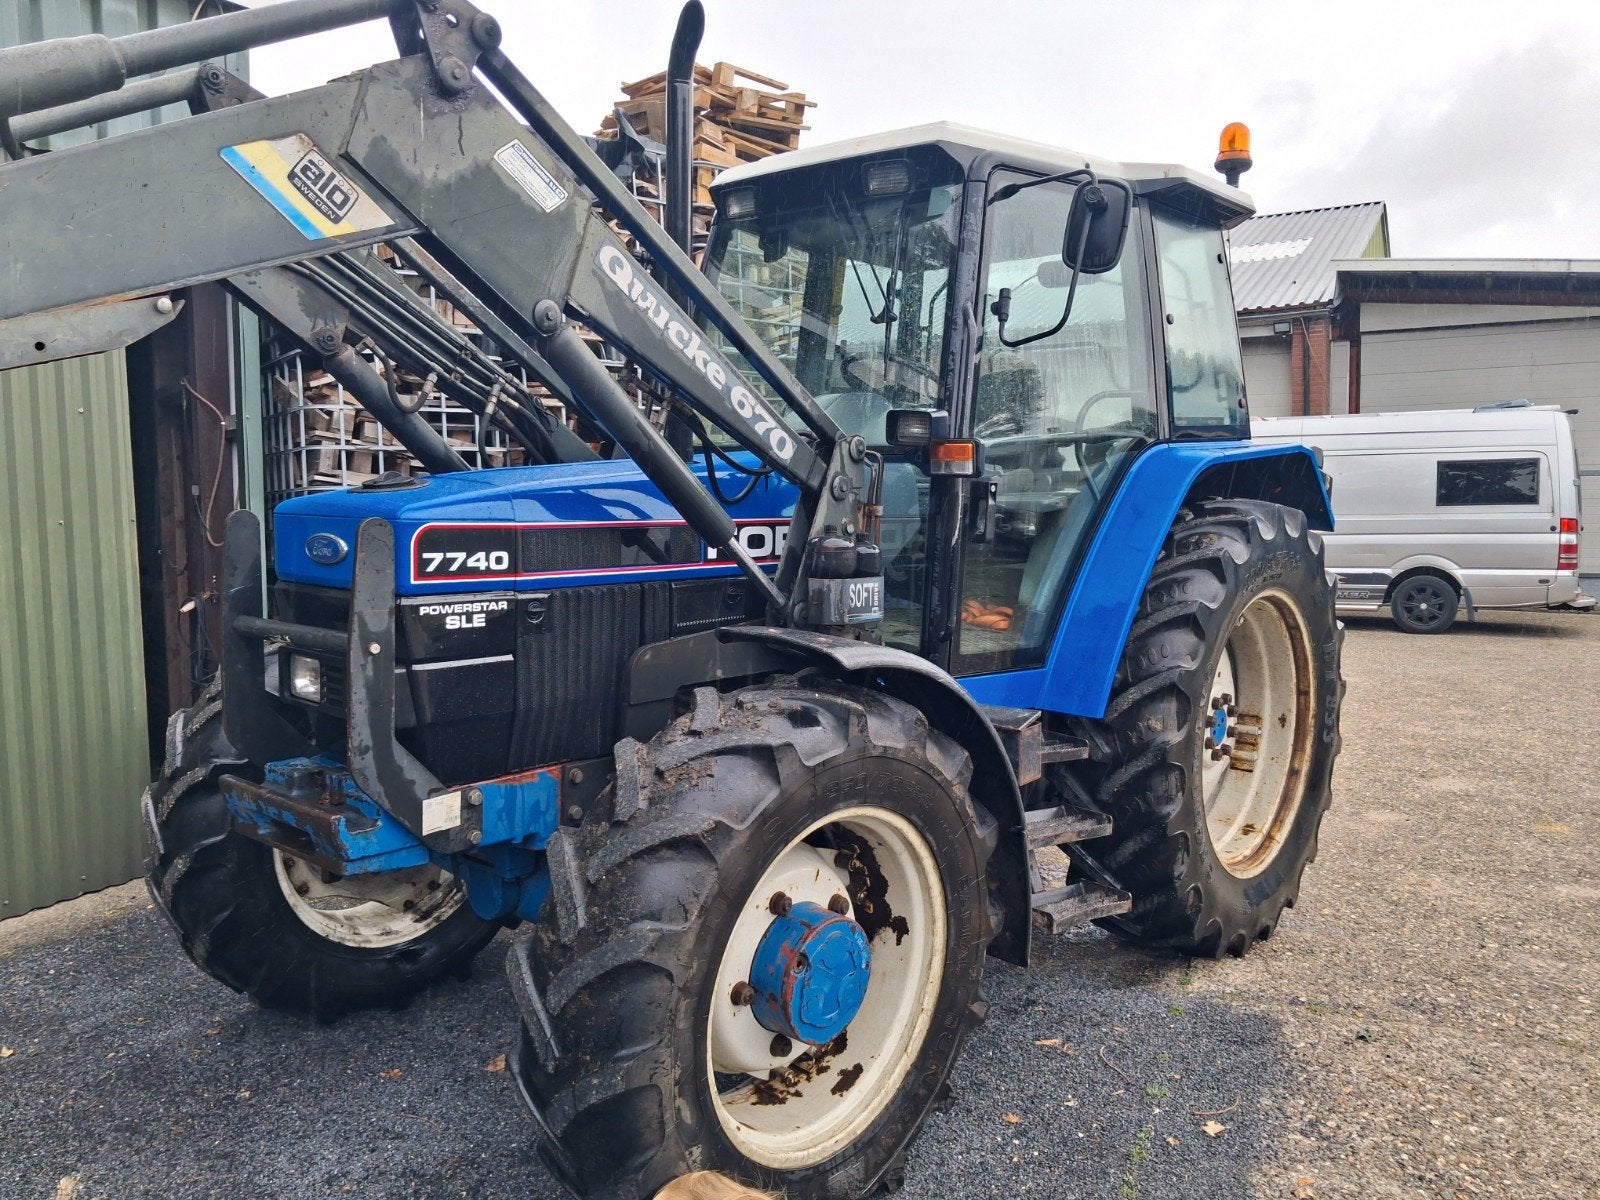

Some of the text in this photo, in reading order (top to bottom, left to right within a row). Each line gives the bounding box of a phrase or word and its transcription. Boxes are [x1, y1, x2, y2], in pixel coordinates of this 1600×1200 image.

[293, 177, 336, 219] SWEDEN
[600, 245, 726, 390] Quicke
[731, 386, 796, 460] 670
[422, 551, 509, 572] 7740
[850, 583, 873, 608] SOFT
[1337, 591, 1370, 599] TER
[419, 601, 508, 616] POWERSTAR
[445, 613, 486, 630] SLE
